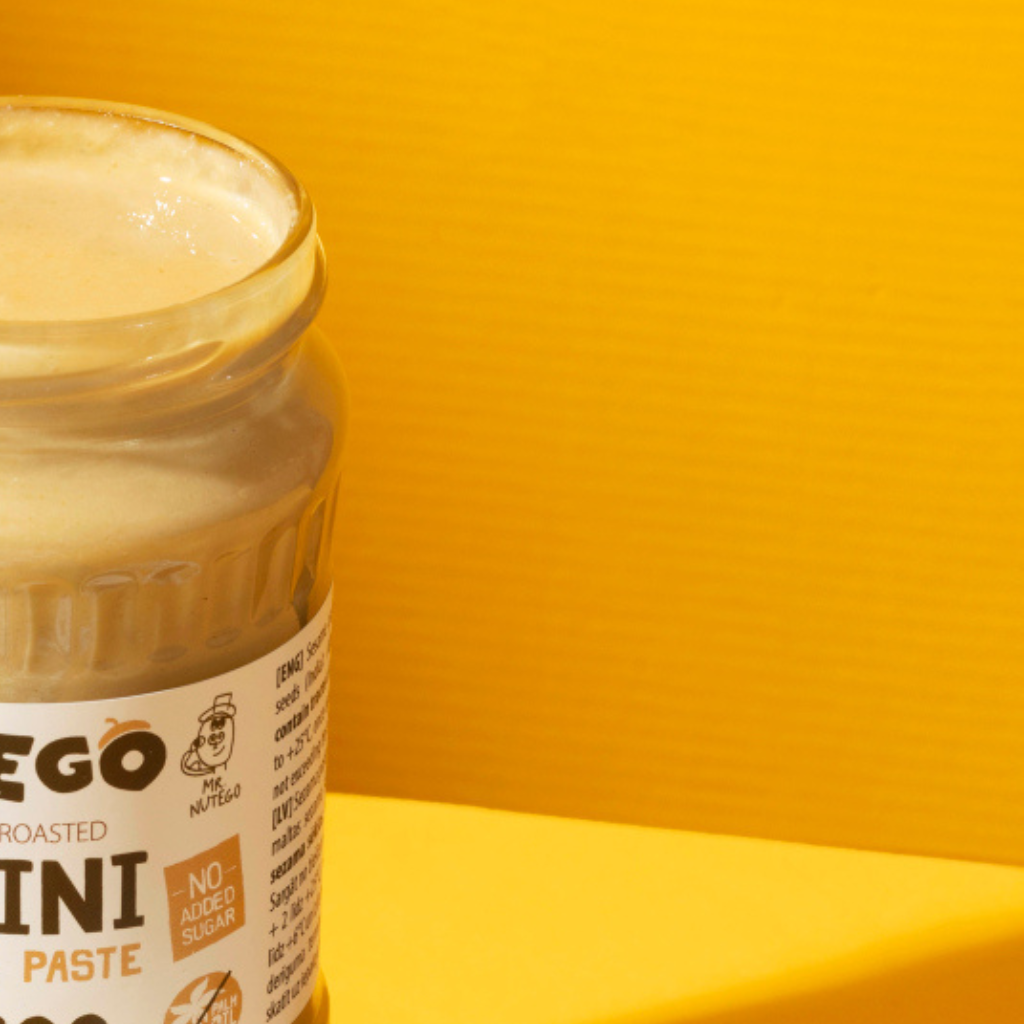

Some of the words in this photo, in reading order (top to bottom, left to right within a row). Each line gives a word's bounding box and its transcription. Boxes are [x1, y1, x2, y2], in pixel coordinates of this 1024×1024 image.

[274, 683, 301, 715] seeds
[274, 702, 310, 742] contain
[274, 753, 285, 771] to
[189, 783, 241, 818] NUTEGO
[272, 775, 289, 801] not
[271, 796, 293, 831] [LV]
[189, 861, 222, 899] NO
[180, 885, 235, 926] ADDED
[181, 906, 236, 947] SUGAR
[23, 942, 143, 983] PASTE
[210, 994, 238, 1016] PALM
